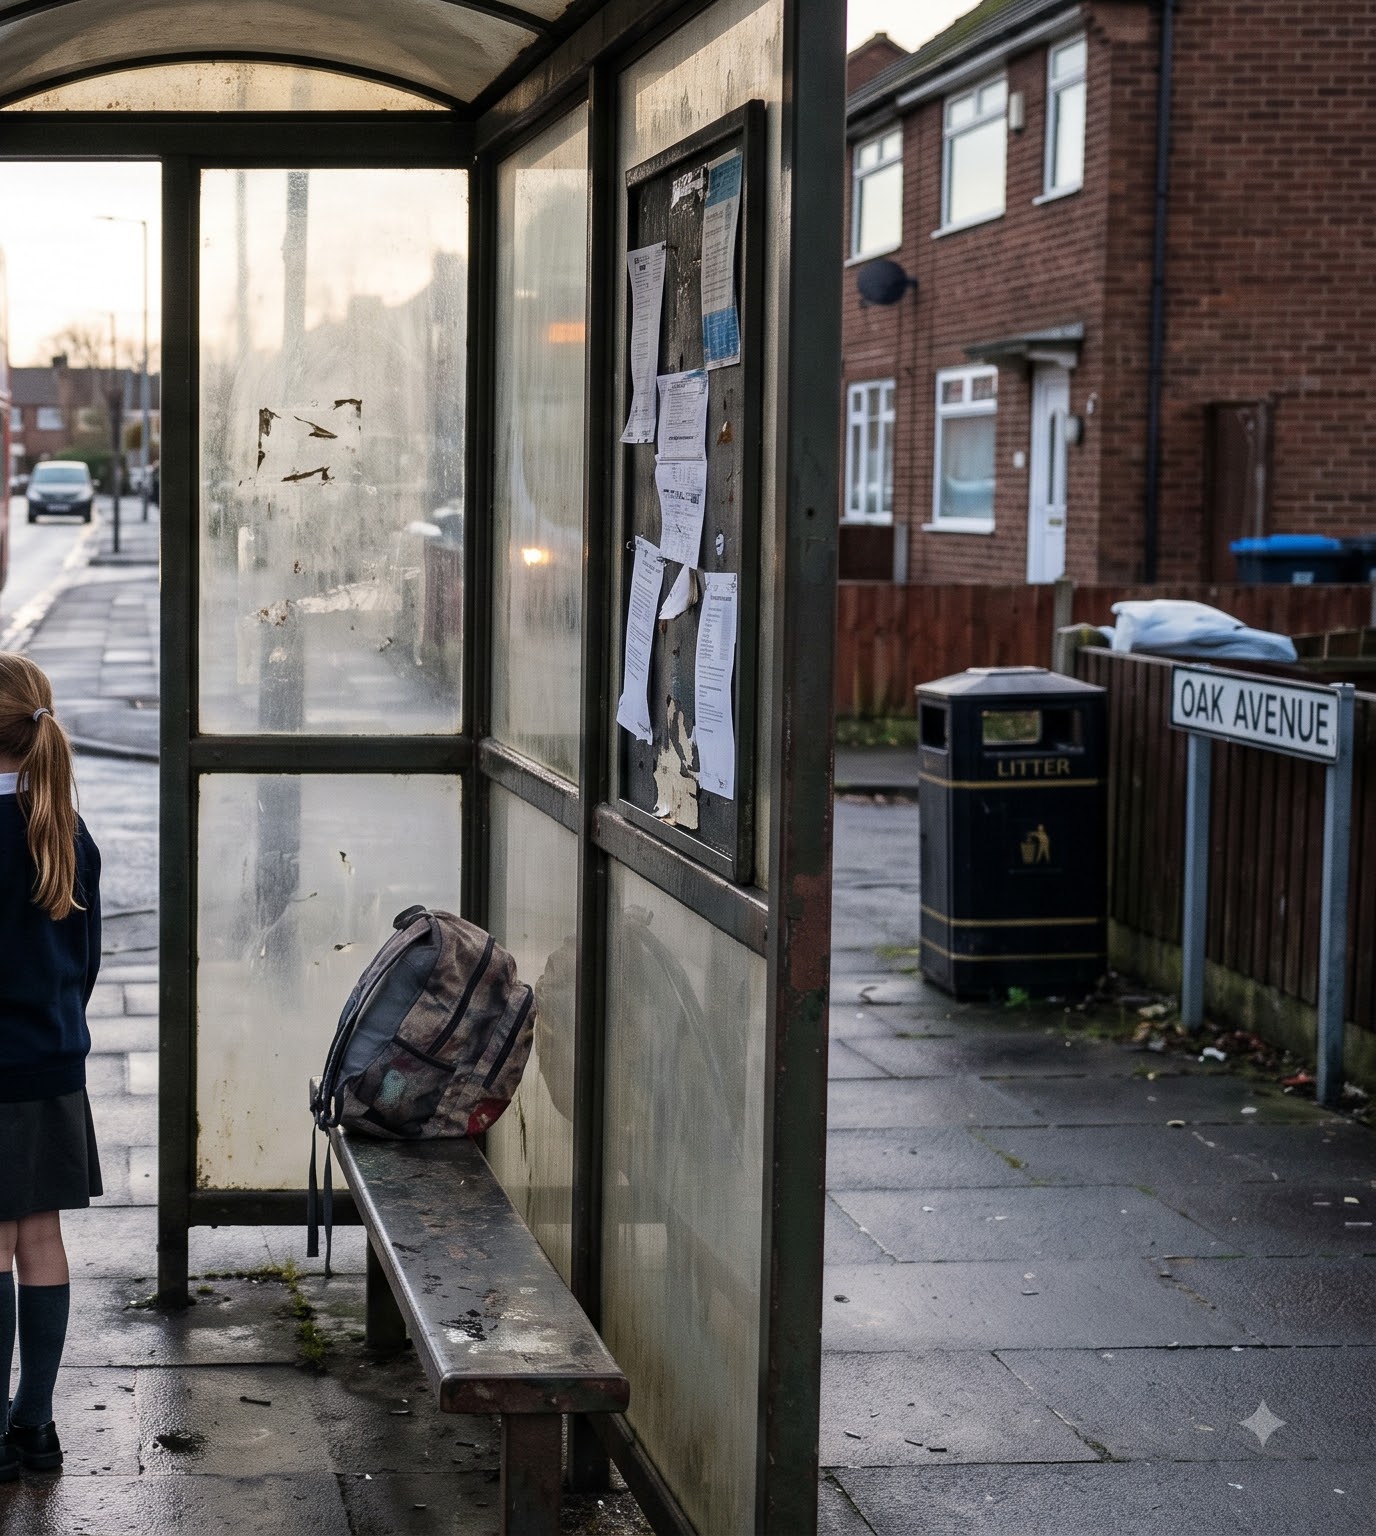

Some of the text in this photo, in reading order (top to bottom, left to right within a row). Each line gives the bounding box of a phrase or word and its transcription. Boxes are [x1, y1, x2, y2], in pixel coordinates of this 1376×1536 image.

[1181, 679, 1328, 746] OAK AVENUE
[997, 758, 1070, 777] LITTER
